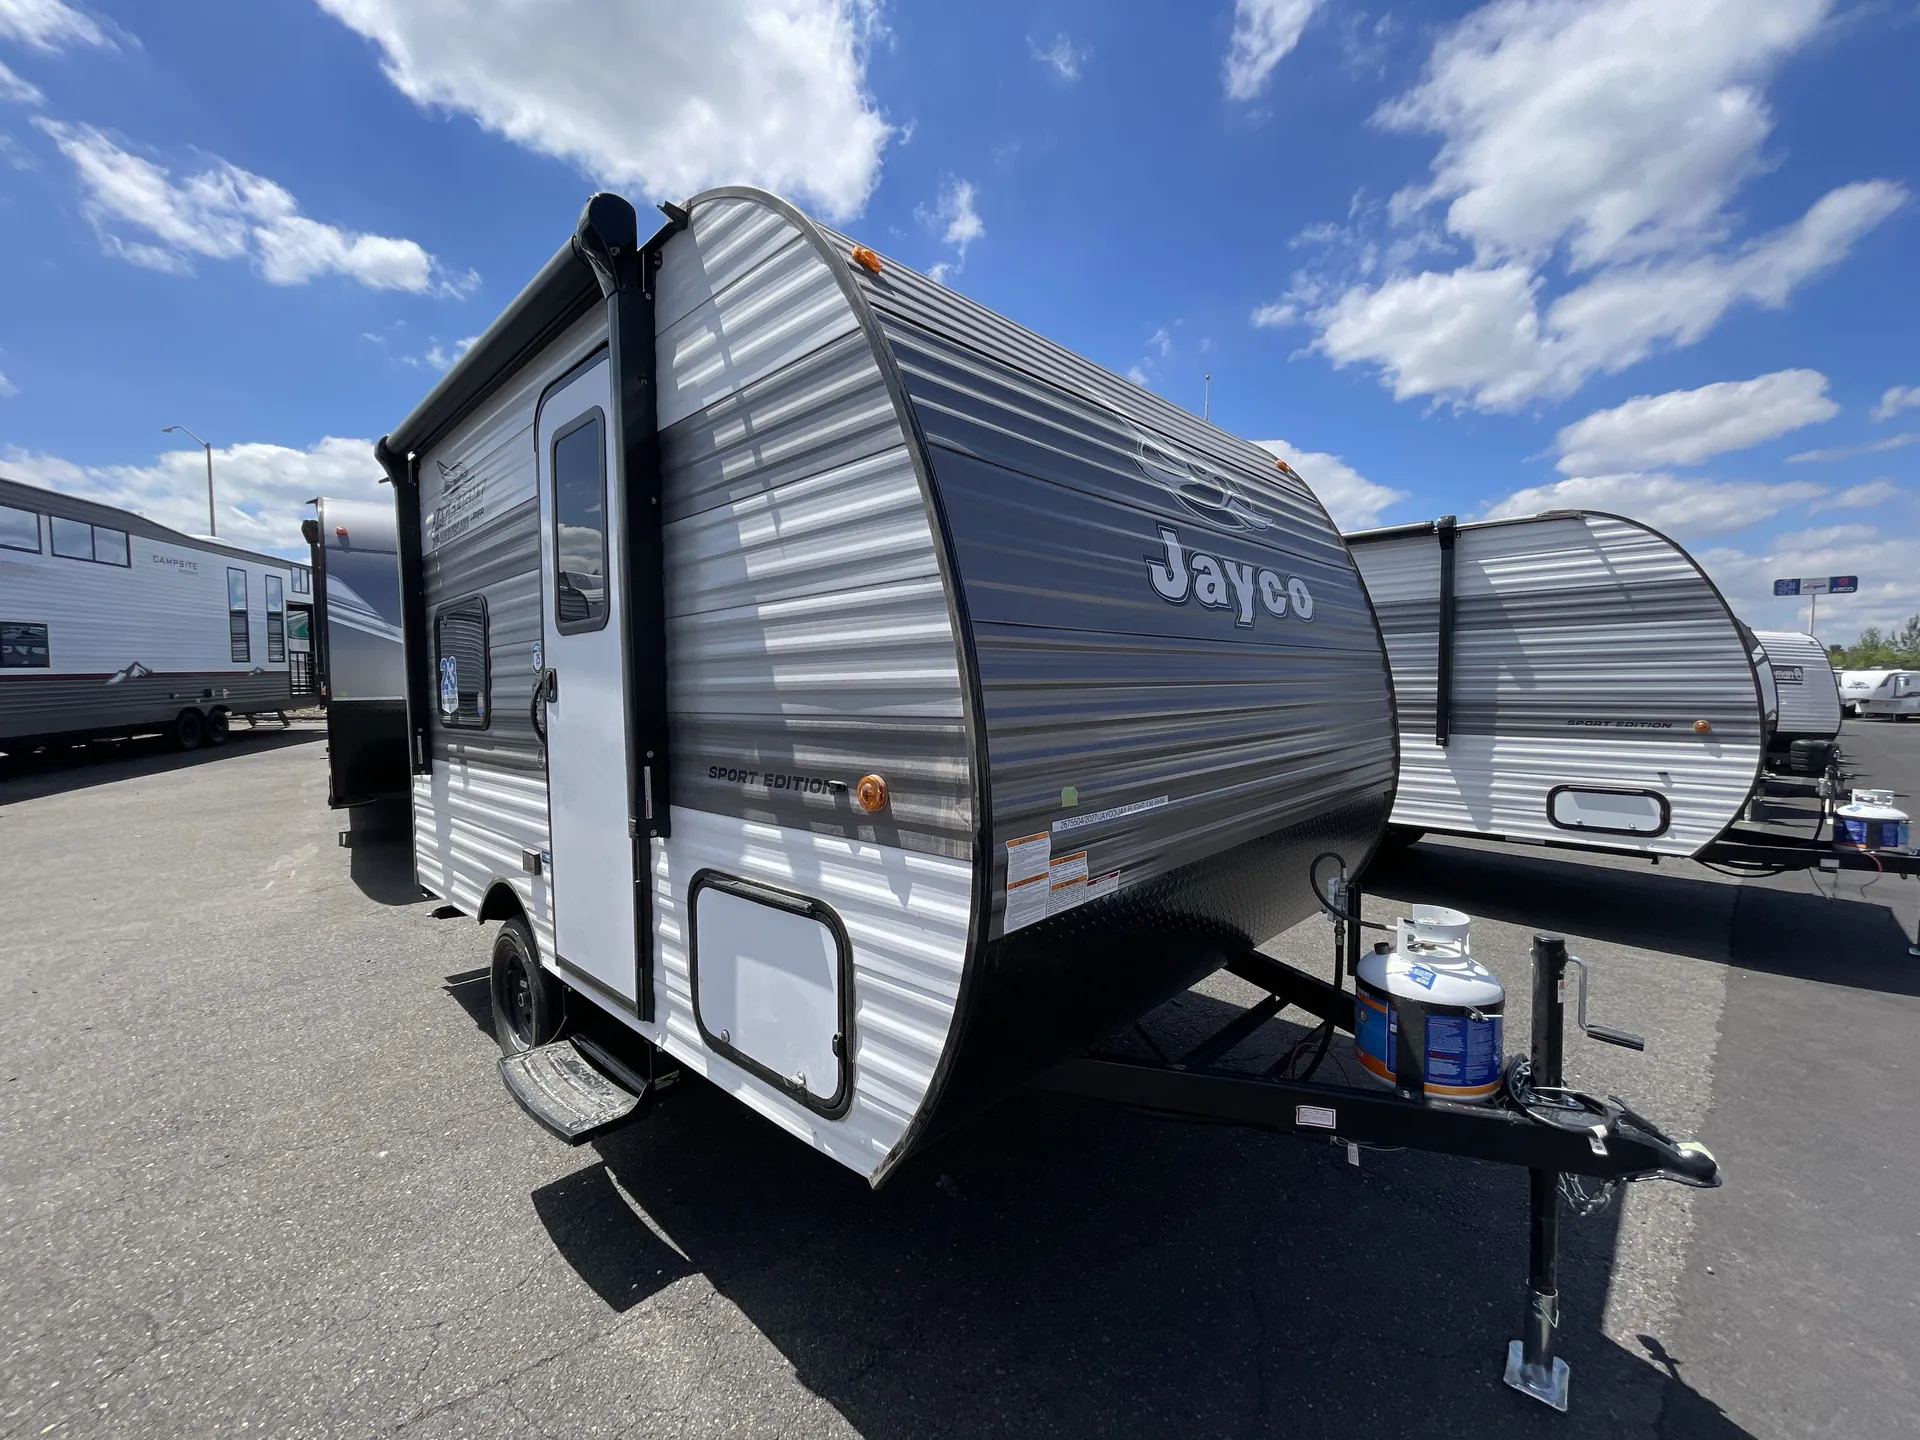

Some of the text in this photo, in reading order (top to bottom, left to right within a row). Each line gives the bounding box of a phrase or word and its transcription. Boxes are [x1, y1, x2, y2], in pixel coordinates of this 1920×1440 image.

[152, 555, 198, 570] CAMPSITE
[1144, 522, 1315, 629] Jayco
[1566, 719, 1612, 727] SPORT
[709, 766, 759, 784] SPORT
